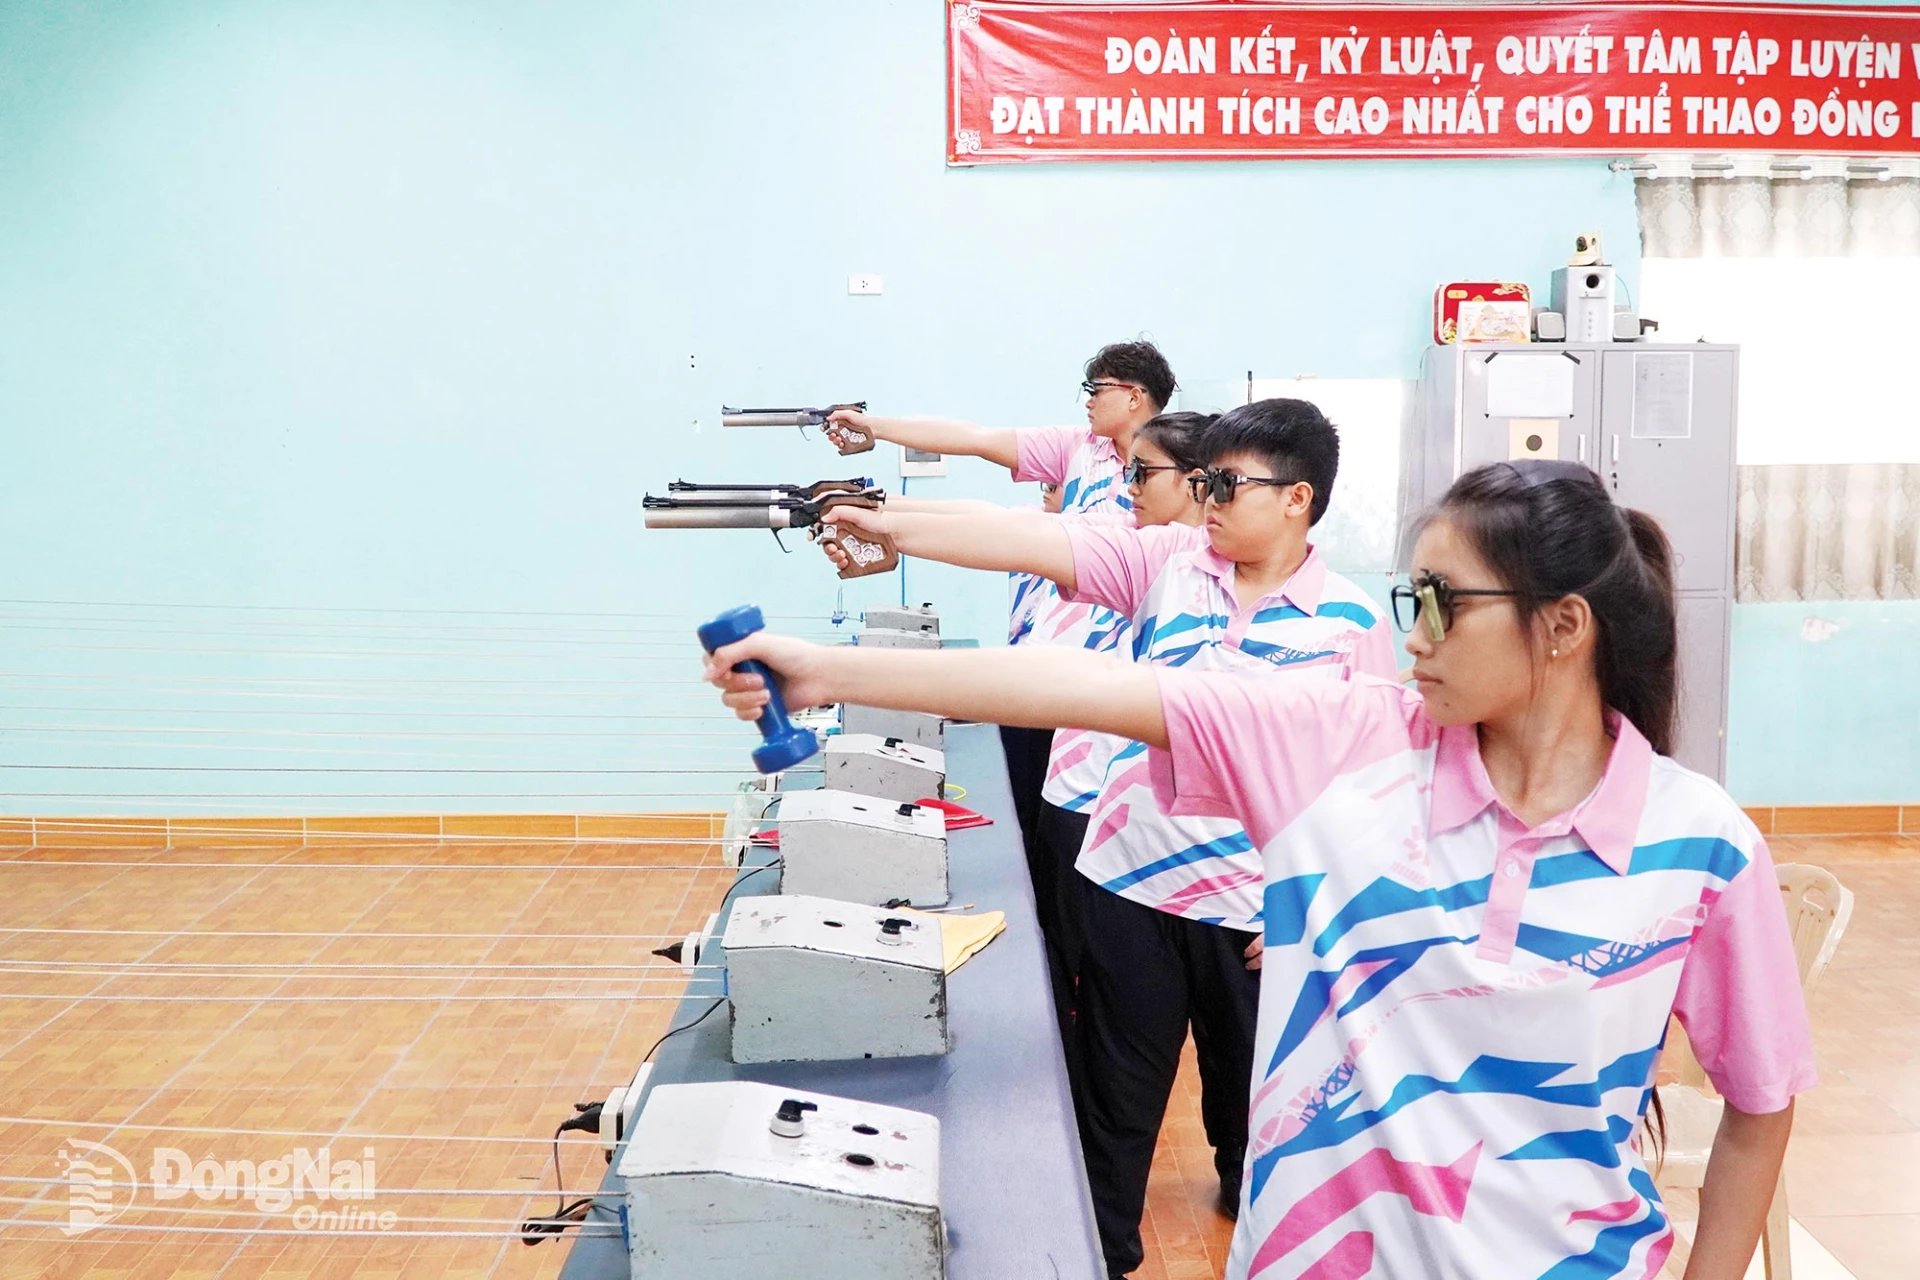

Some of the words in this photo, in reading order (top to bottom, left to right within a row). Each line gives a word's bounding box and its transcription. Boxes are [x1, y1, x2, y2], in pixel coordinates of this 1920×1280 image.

[1104, 29, 1215, 74] ĐOÀN
[1231, 24, 1308, 82] KẾT,
[1321, 26, 1369, 74] KỶ
[1380, 29, 1484, 84] LUẬT,
[1496, 24, 1613, 75] QUYẾT
[1625, 29, 1701, 74] TÂM
[1713, 31, 1779, 85] TẬP
[1791, 34, 1900, 88] LUYỆN
[991, 97, 1064, 144] ĐẠT
[1075, 88, 1204, 135] THÀNH
[1218, 89, 1300, 135] TÍCH
[1314, 97, 1390, 135] CAO
[1403, 84, 1503, 135] NHẤT
[1516, 95, 1592, 134] CHO
[1605, 82, 1671, 134] THỂ
[1683, 97, 1780, 135] THAO
[1792, 87, 1900, 138] ĐỒNG
